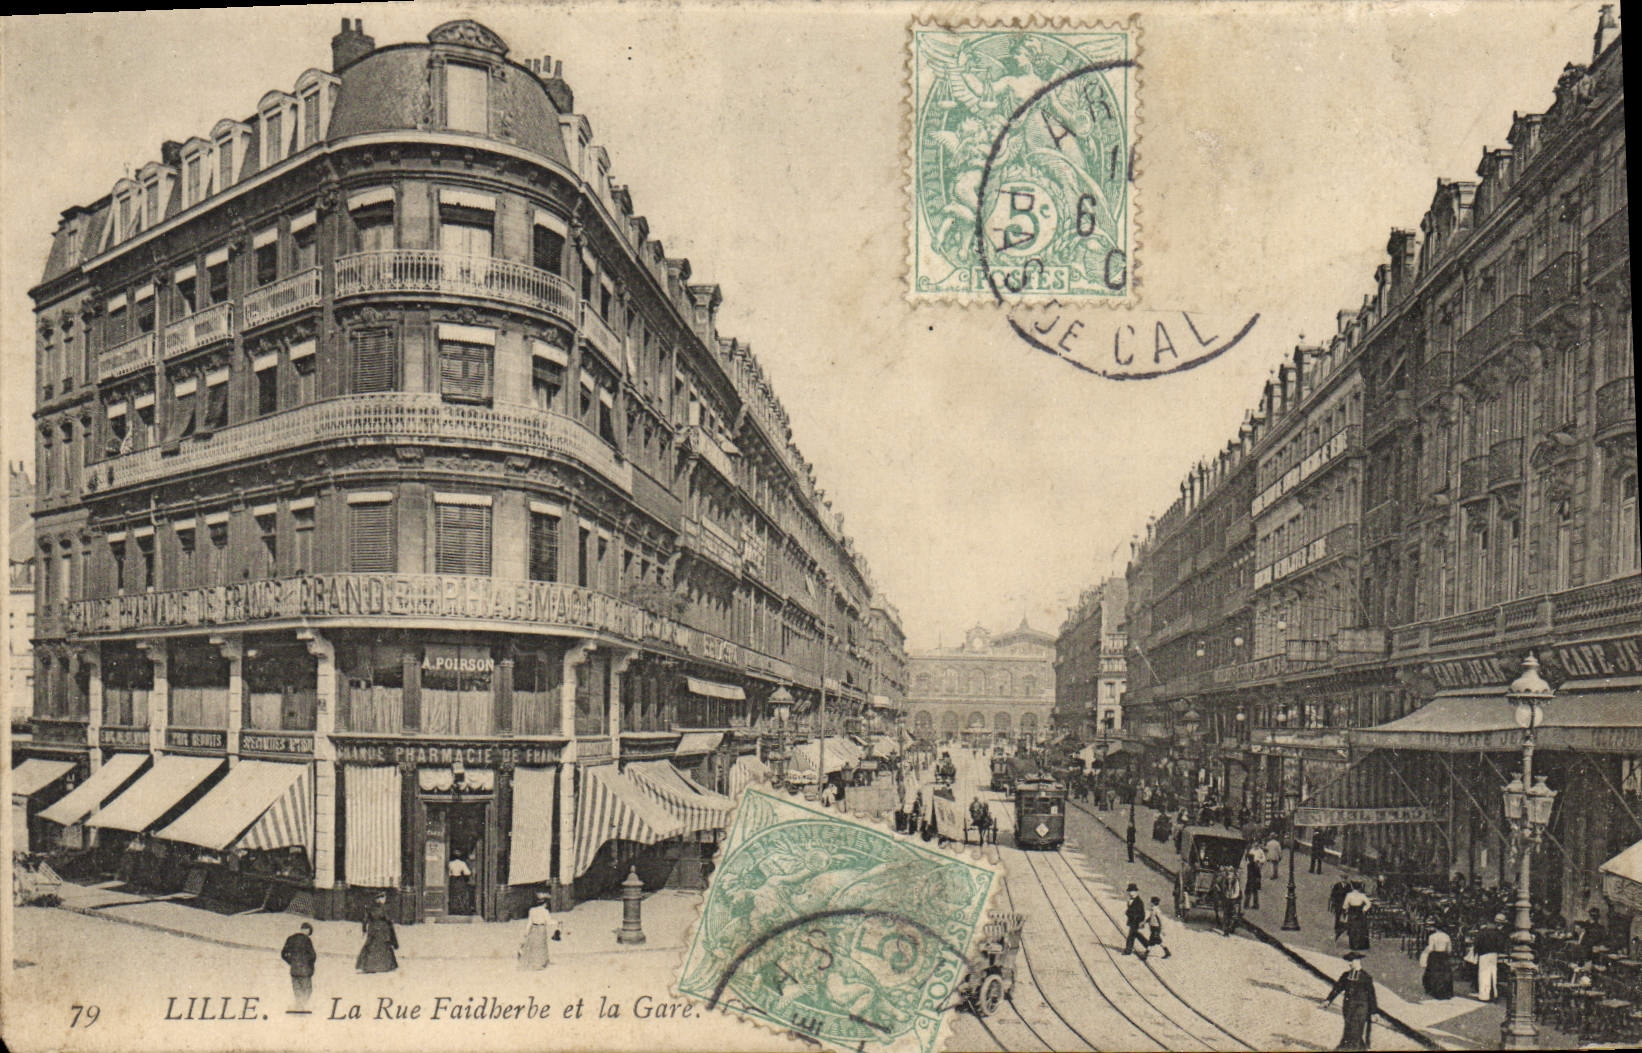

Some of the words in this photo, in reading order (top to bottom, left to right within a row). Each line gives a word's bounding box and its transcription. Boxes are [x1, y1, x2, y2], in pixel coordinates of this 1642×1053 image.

[975, 268, 1067, 291] POSTES
[299, 576, 409, 616] GRANDE
[395, 746, 493, 763] PHARMACIE
[503, 748, 520, 763] DE
